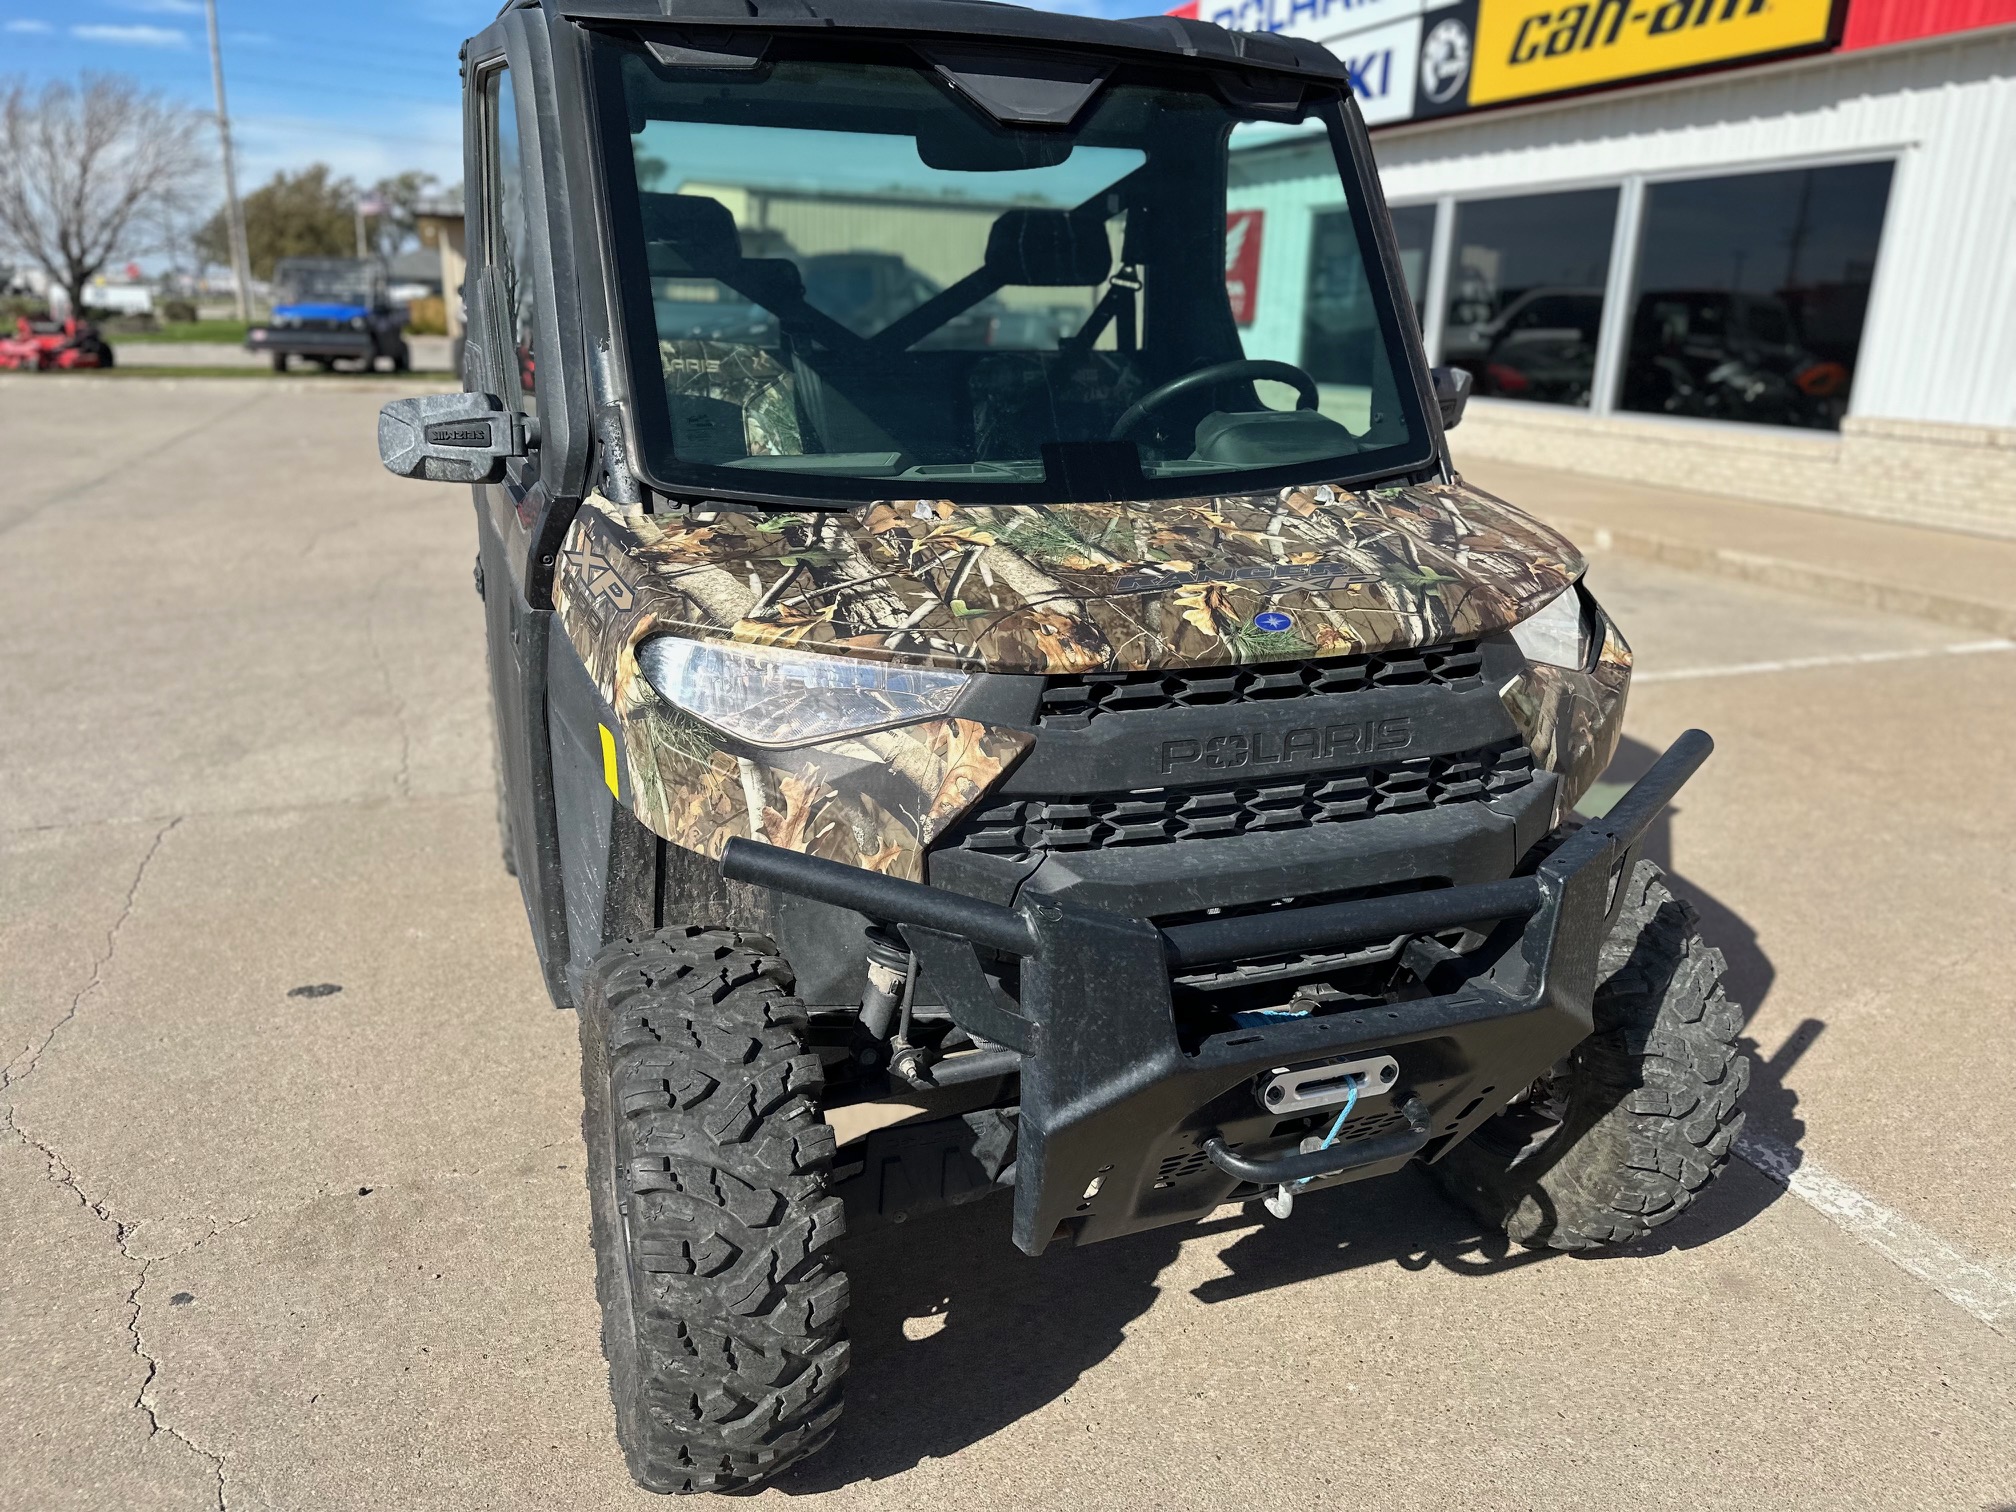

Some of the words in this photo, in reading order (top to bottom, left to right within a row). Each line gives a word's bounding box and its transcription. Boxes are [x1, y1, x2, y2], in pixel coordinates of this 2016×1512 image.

[562, 530, 636, 613] XP
[1114, 562, 1351, 592] RANGER
[1256, 573, 1386, 597] XP
[1160, 716, 1414, 775] POLARIS
